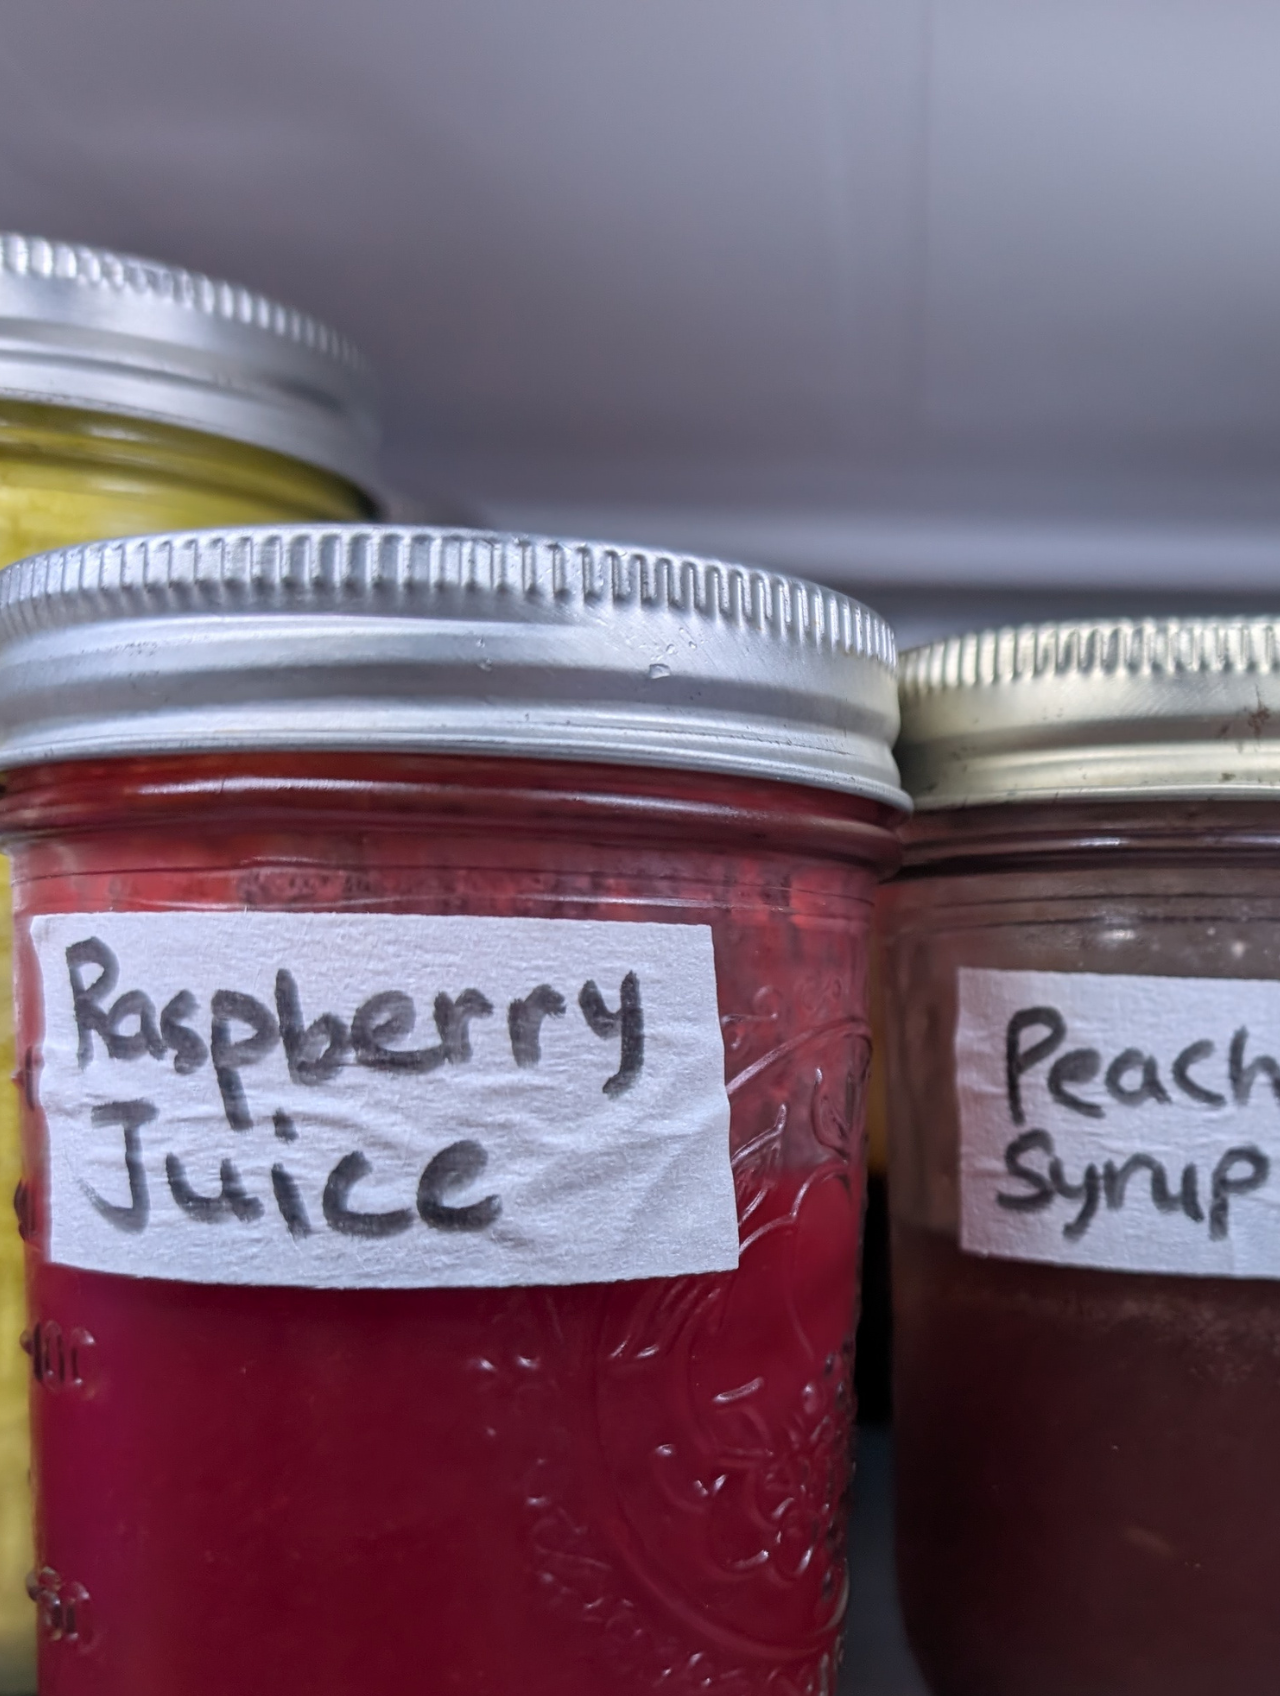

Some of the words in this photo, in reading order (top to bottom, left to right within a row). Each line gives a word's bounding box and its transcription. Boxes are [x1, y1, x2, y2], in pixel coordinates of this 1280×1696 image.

[65, 936, 645, 1131] Raspberry
[85, 1098, 502, 1239] Juice
[996, 1128, 1271, 1242] Syrup
